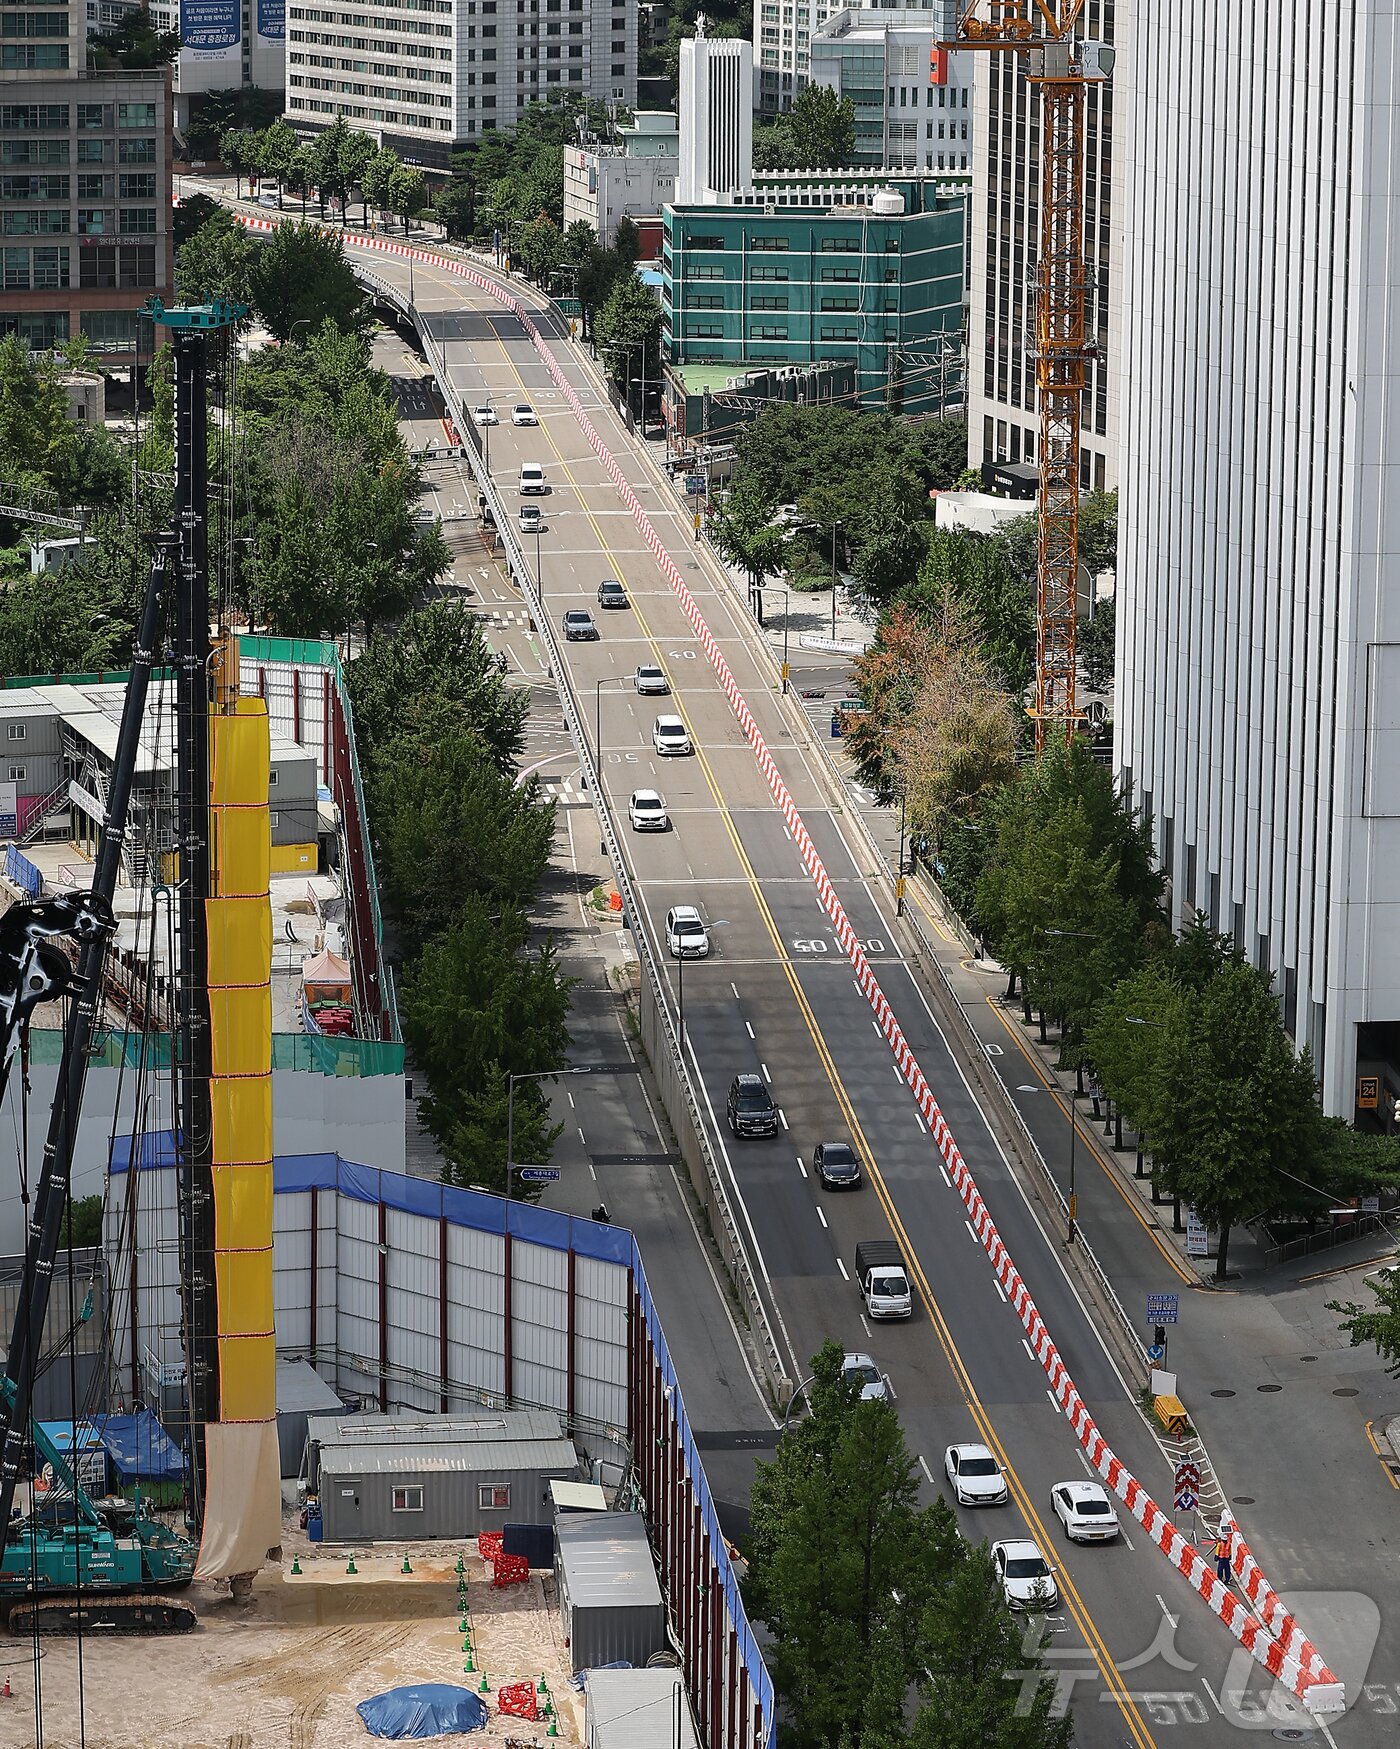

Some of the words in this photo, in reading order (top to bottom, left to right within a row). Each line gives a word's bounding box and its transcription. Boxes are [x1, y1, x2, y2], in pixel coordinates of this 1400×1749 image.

[184, 35, 206, 44] 서대문
[207, 33, 236, 44] 충정로점
[668, 650, 697, 659] 40
[1362, 1087, 1375, 1096] 24
[87, 1560, 115, 1568] SUNWARD
[1143, 1691, 1210, 1725] 50
